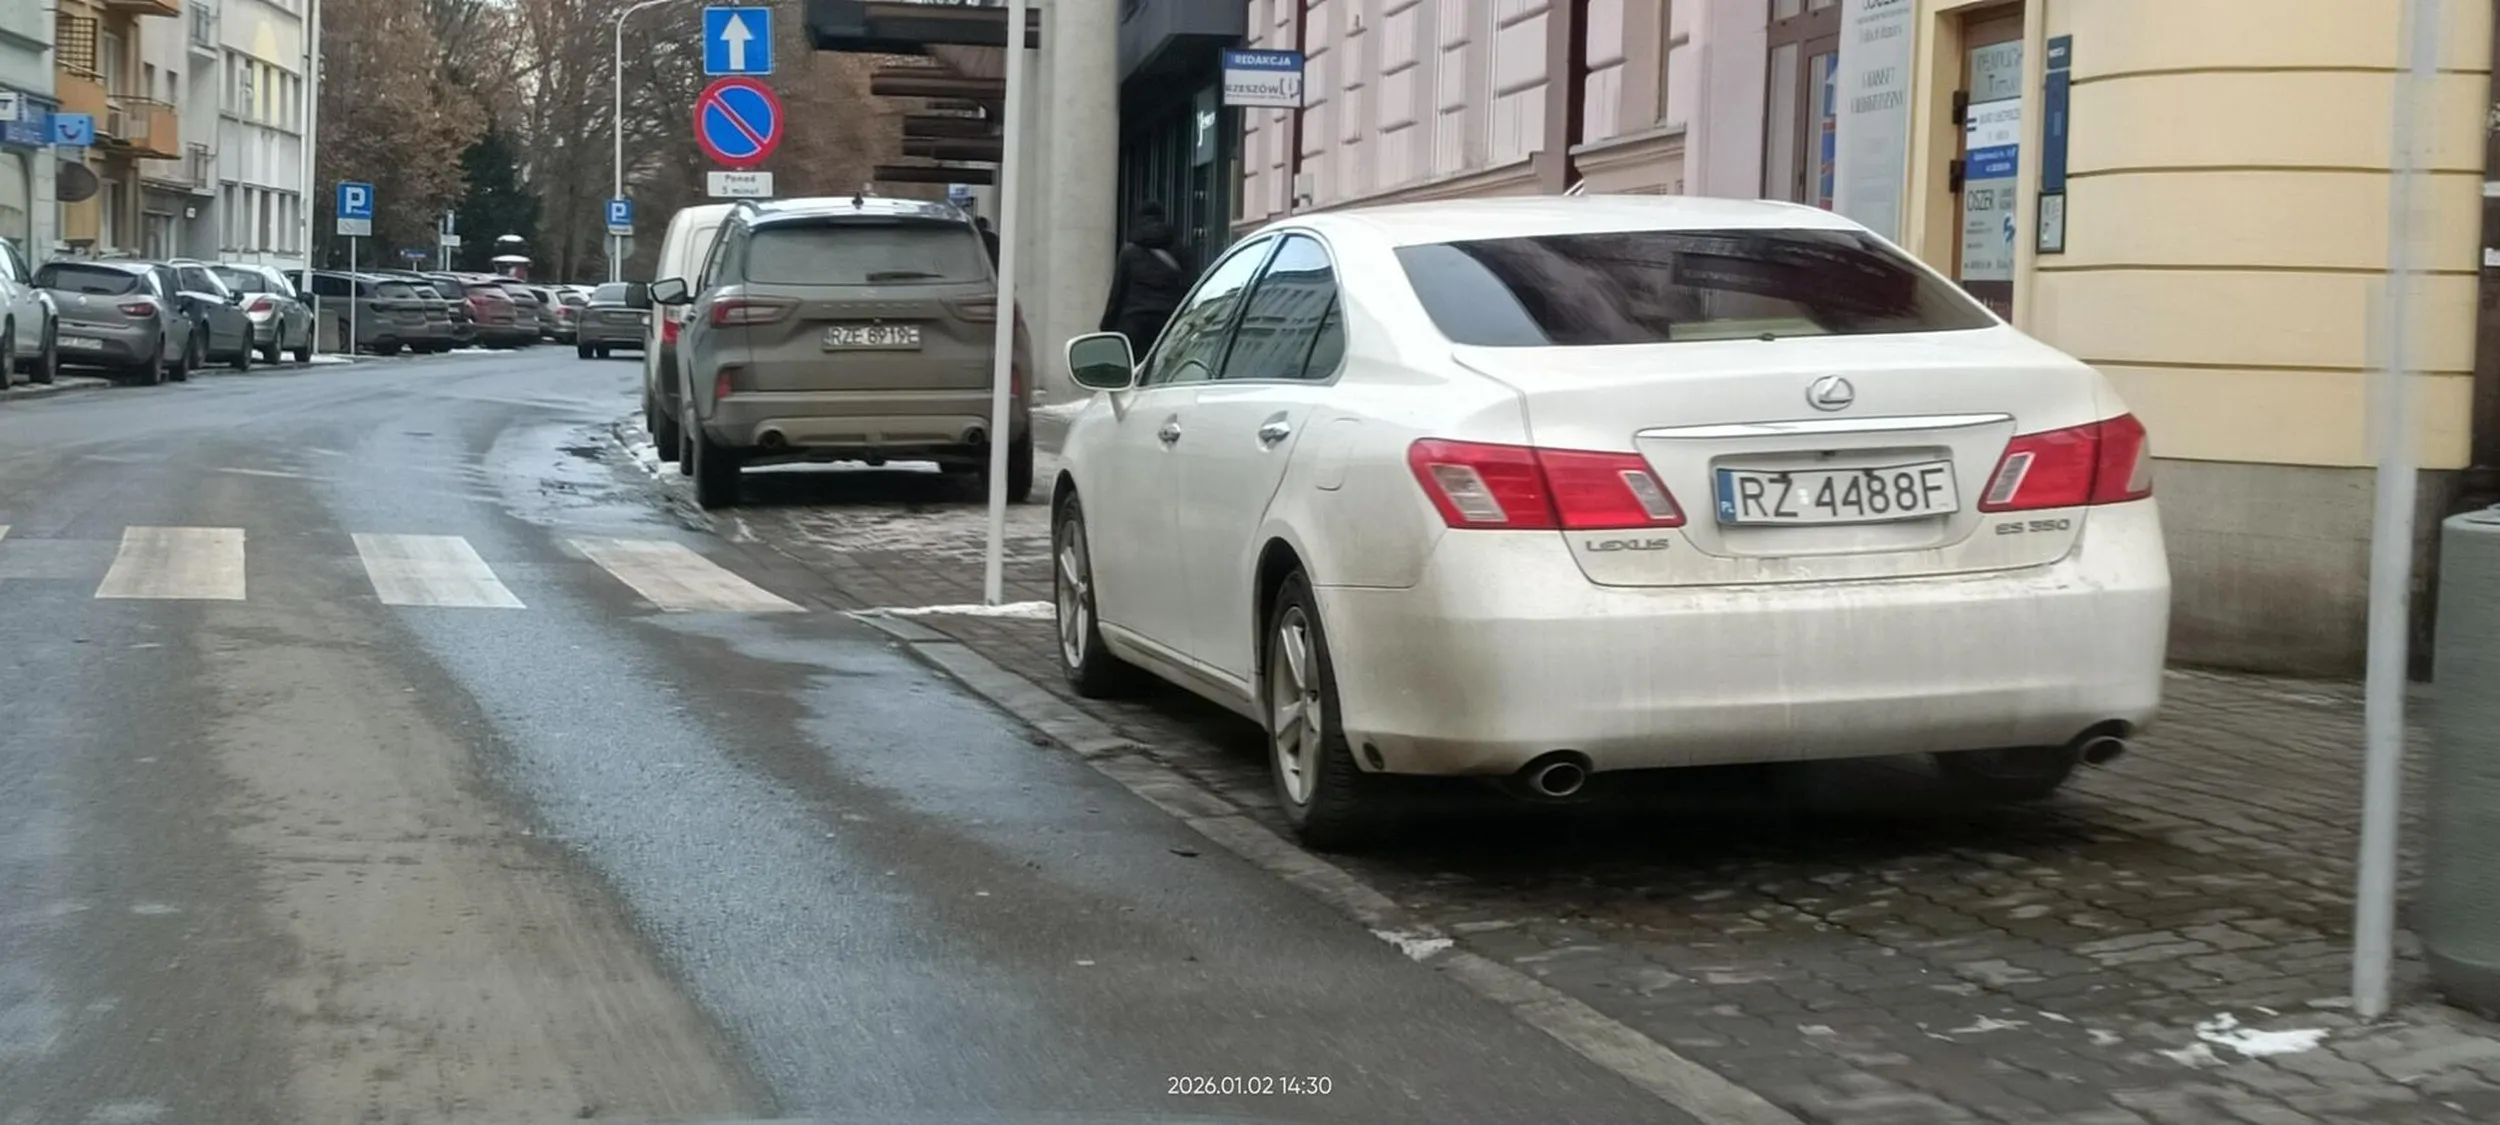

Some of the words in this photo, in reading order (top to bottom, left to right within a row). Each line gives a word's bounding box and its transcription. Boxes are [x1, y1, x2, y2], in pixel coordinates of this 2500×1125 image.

[1234, 54, 1291, 66] REDAKCJA
[724, 174, 756, 184] Ponad
[731, 187, 760, 195] minut
[345, 186, 366, 214] P
[611, 202, 627, 222] P
[1739, 476, 1799, 518] RZ
[1814, 467, 1945, 517] 4488F
[1994, 522, 2024, 535] ES
[2028, 519, 2071, 532] 350
[1585, 539, 1670, 552] LEXUS
